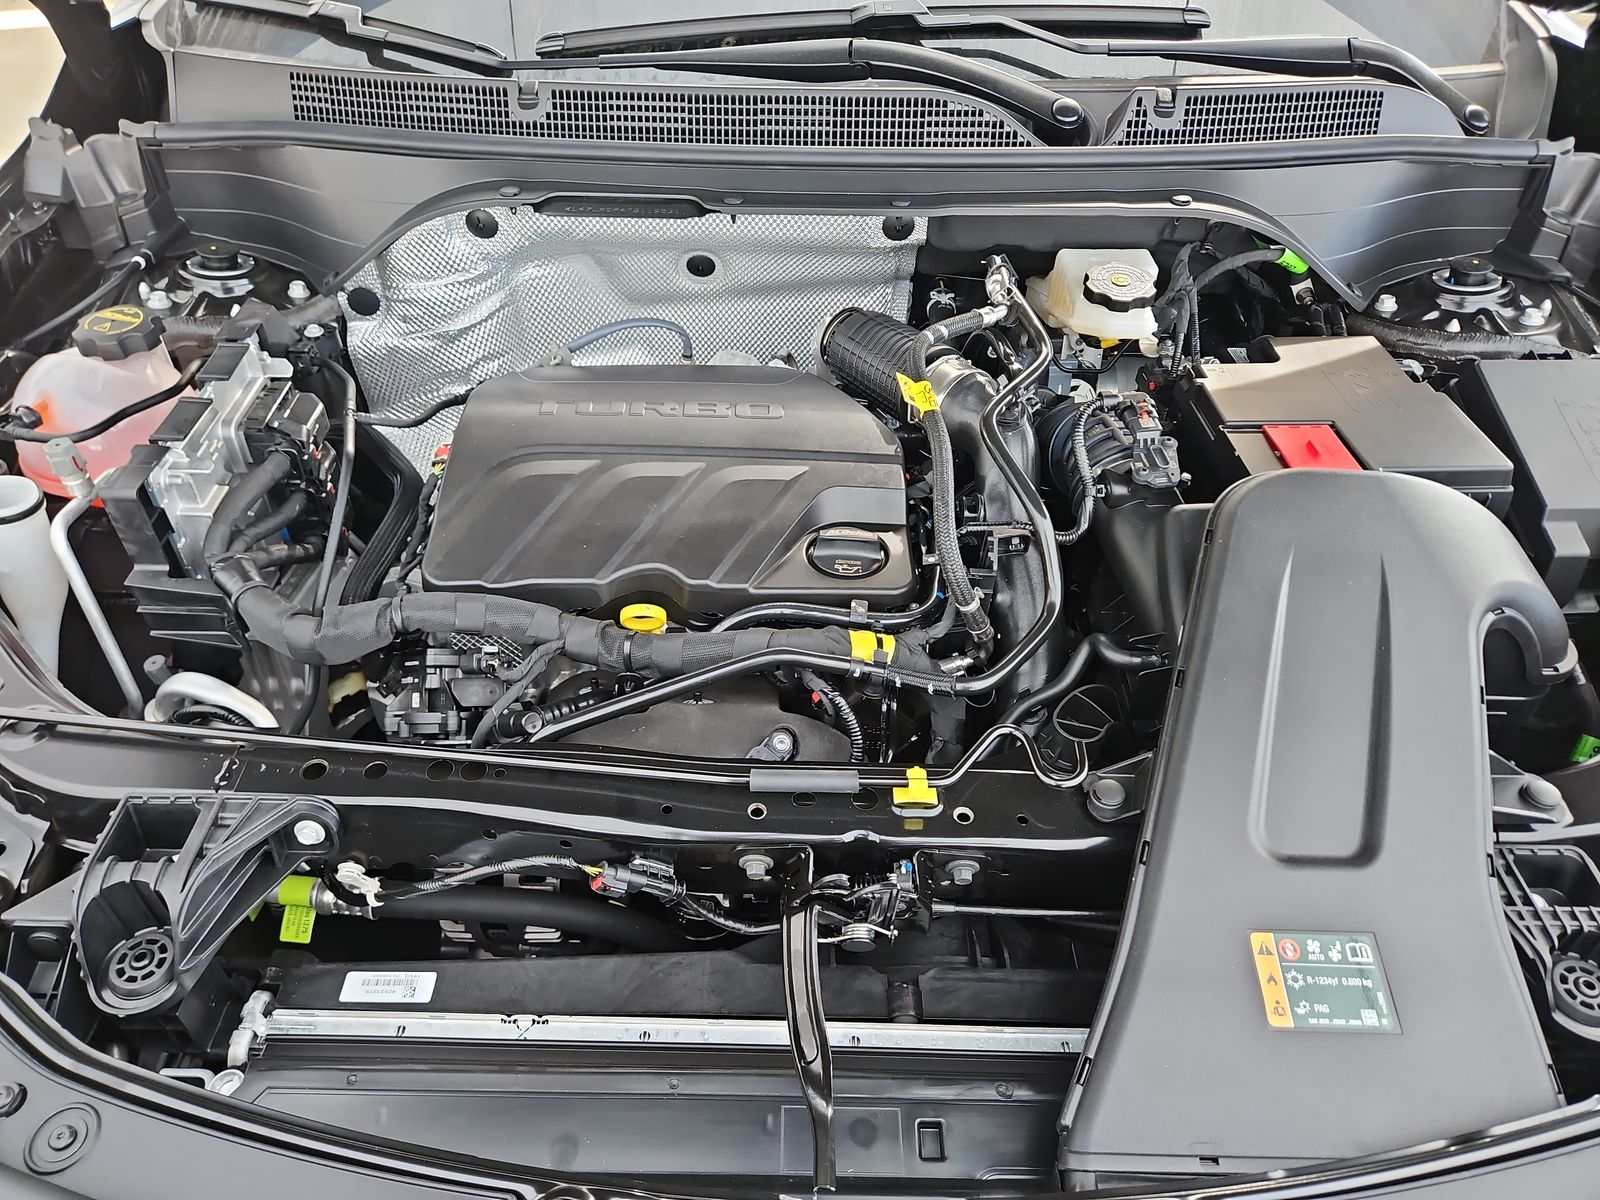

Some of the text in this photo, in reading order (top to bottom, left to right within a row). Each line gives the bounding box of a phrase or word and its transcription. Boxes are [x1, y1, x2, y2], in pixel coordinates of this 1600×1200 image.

[528, 399, 786, 420] TURBO
[1308, 953, 1325, 962] AUTO
[1362, 978, 1373, 988] kg
[1313, 1003, 1330, 1014] PAG
